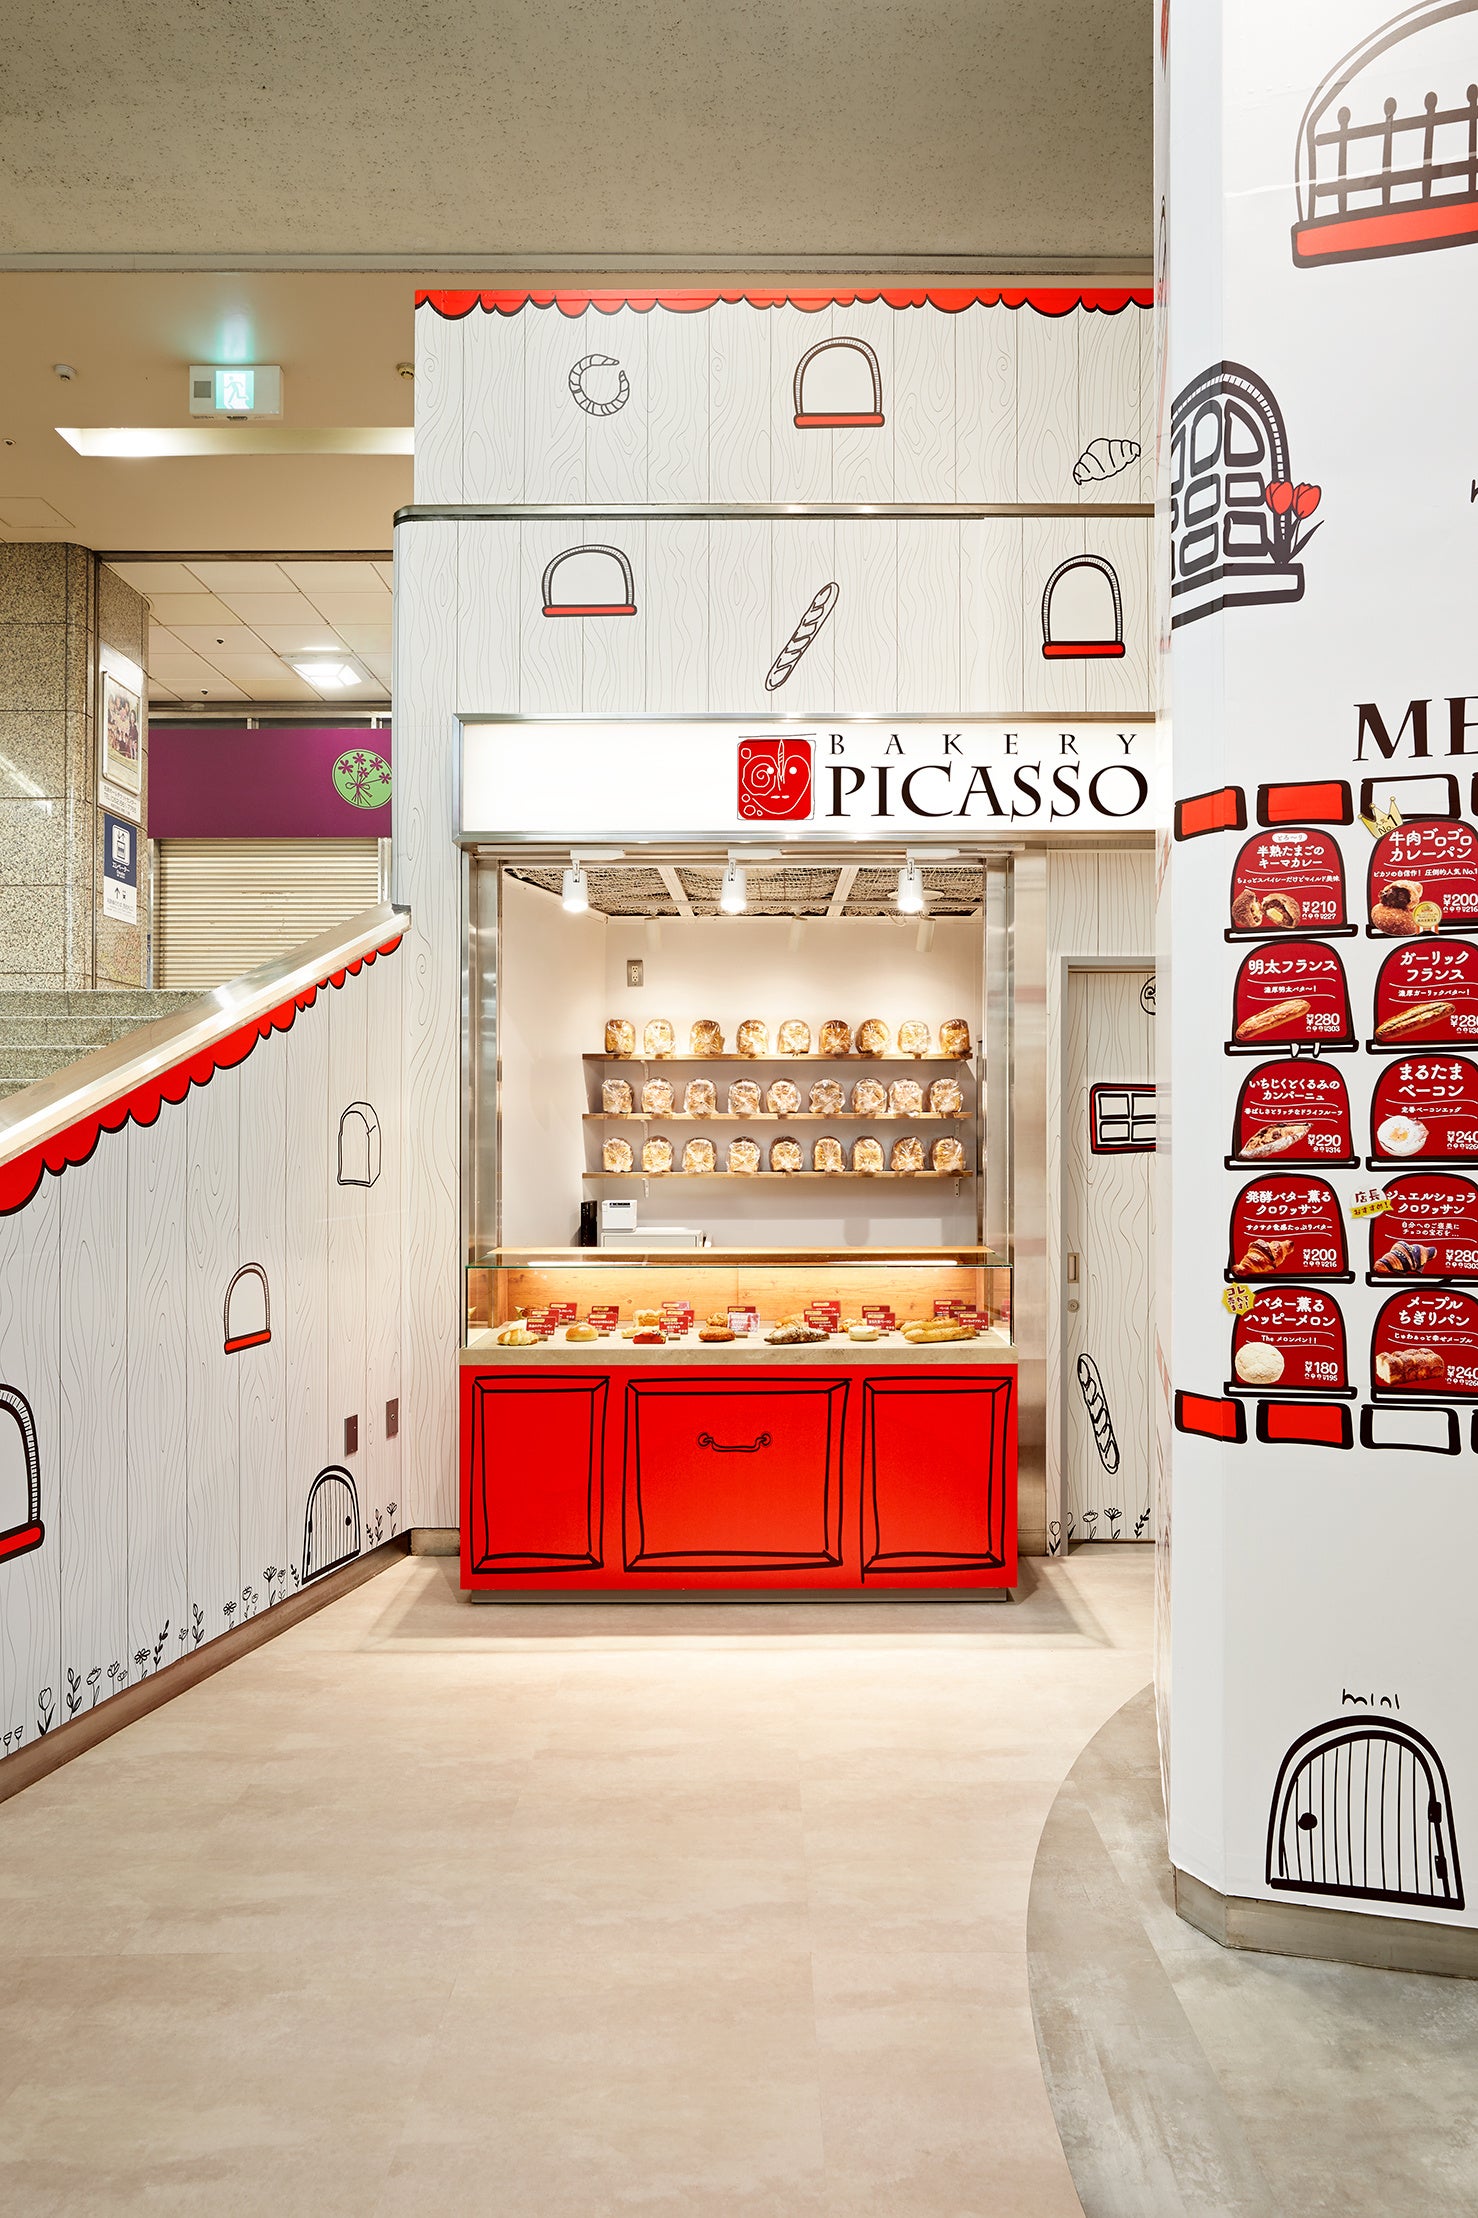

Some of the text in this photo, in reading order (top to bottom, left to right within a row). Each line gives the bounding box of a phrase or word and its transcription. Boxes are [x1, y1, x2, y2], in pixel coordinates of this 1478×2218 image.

[1353, 696, 1478, 761] ME
[828, 733, 1138, 755] BAKERY
[825, 760, 1149, 823] PICASSO
[1389, 828, 1472, 846] 牛肉ゴロゴロ
[1257, 845, 1324, 857] 半熟たまごの
[1390, 846, 1472, 862] カレーパン
[1259, 858, 1322, 869] キーマカレー
[1400, 951, 1469, 966] ガーリック
[1248, 959, 1337, 975] 明太フランス
[1406, 968, 1464, 982] フランス
[1450, 1015, 1478, 1027] ¥28
[1399, 1063, 1463, 1081] まるたま
[1249, 1078, 1340, 1090] いちじくとくるみの
[1398, 1084, 1465, 1097] ベーコン
[1262, 1090, 1325, 1101] カンパーニュ
[1246, 1190, 1331, 1203] 発酵バター薫る
[1386, 1190, 1476, 1203] ジュエルショコラ
[1255, 1204, 1323, 1215] クロワッサン
[1398, 1203, 1465, 1215] クロワッサン
[1254, 1296, 1325, 1312] バター薫る
[1407, 1296, 1463, 1310] メープル
[1243, 1312, 1336, 1327] ハッピーメロン
[1399, 1310, 1470, 1326] ちぎりパン
